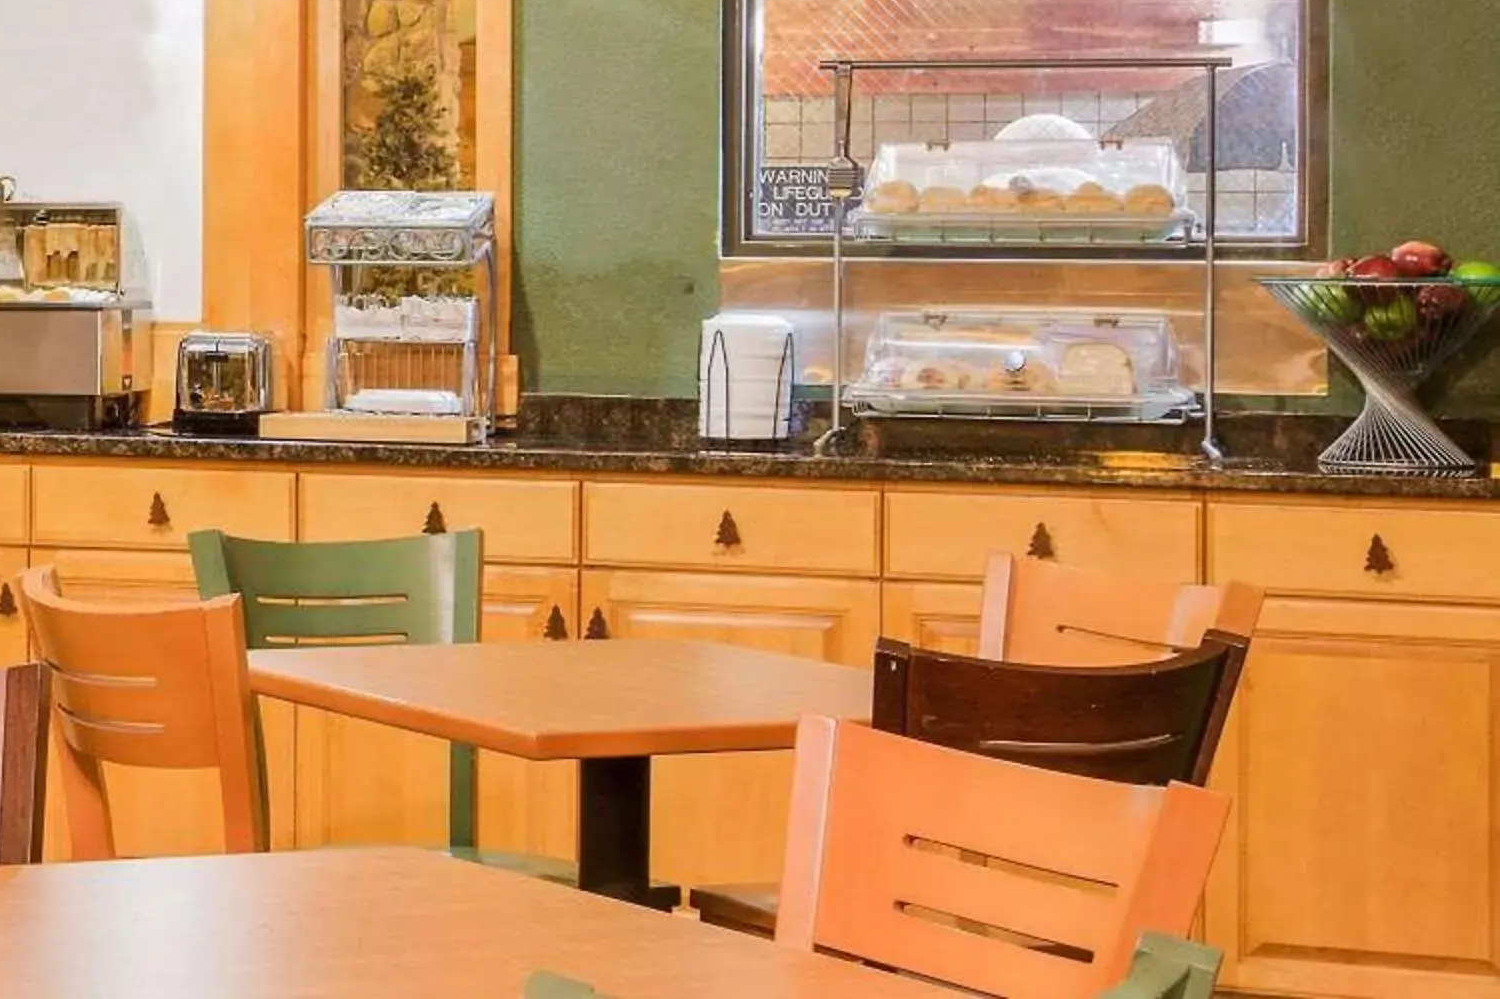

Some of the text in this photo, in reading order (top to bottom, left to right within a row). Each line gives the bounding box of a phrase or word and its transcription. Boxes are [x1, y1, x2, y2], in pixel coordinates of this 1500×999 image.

[760, 169, 829, 184] WARNIN
[773, 185, 865, 200] LIFEGUD
[758, 202, 784, 216] ON
